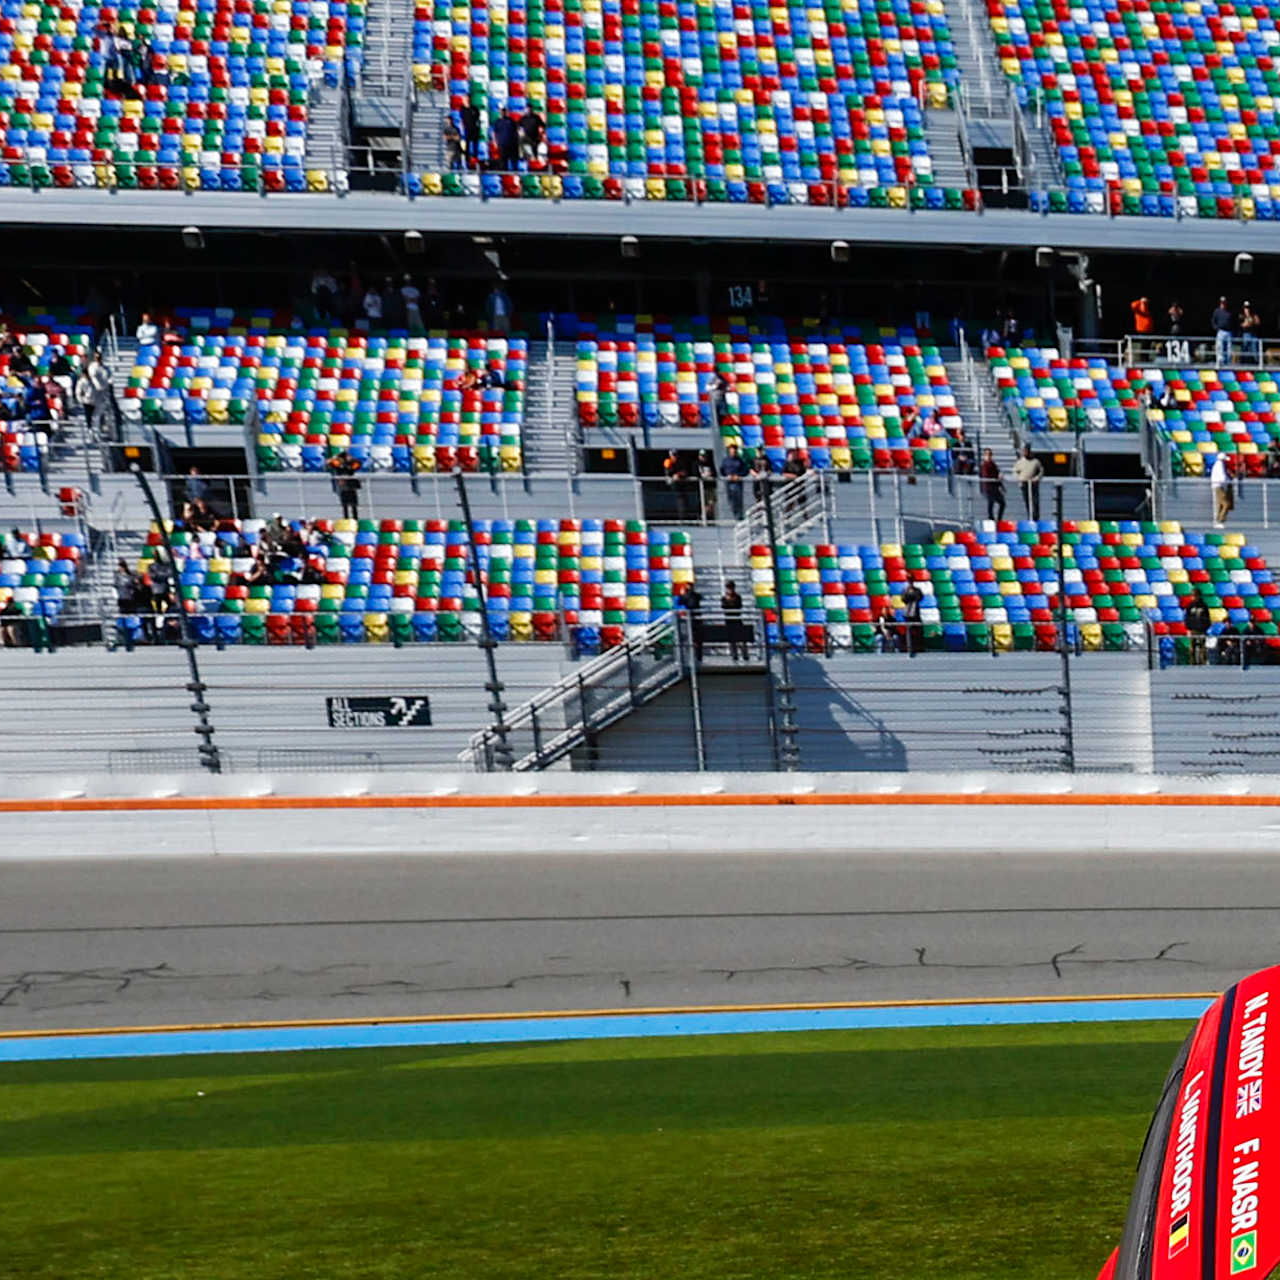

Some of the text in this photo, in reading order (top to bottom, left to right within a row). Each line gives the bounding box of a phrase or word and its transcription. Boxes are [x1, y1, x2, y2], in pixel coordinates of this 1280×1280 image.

[1164, 340, 1191, 364] 134
[331, 698, 352, 712] ALL
[332, 711, 386, 728] SECTIONS
